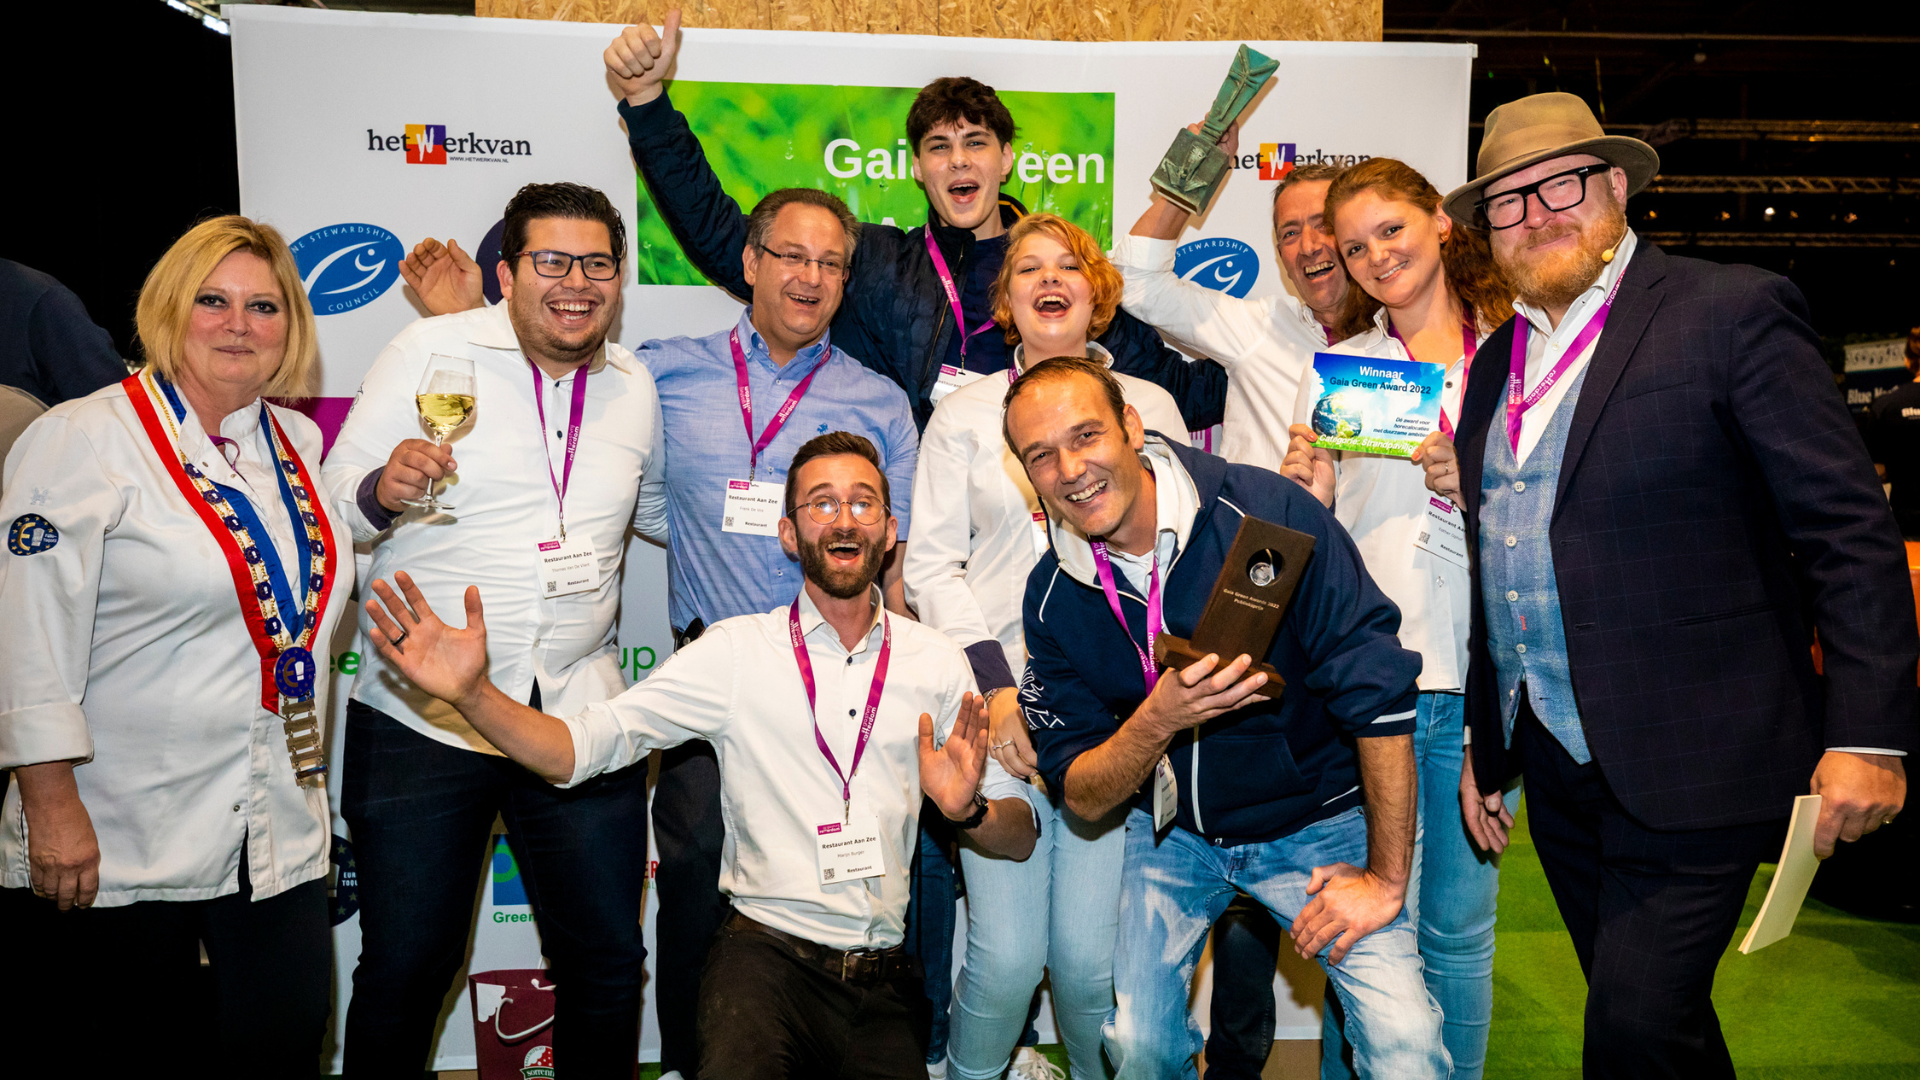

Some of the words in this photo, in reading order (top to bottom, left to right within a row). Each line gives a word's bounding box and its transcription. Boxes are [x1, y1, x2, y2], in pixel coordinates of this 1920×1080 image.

[824, 138, 914, 180] Gai
[1012, 150, 1105, 184] een
[309, 226, 392, 242] STEWARDSHIP
[1176, 240, 1249, 258] STEWARDSHIP
[328, 288, 380, 312] COUNCIL
[1359, 366, 1405, 380] Winnaar
[1329, 376, 1350, 387] Gaia
[1351, 378, 1378, 389] Green
[1379, 381, 1408, 392] Award
[1409, 384, 1432, 395] 2022
[1525, 369, 1557, 403] rotterdam
[568, 426, 580, 461] rotterdam
[1319, 434, 1360, 446] Categorie:
[728, 494, 756, 502] Restaurant
[1428, 511, 1457, 528] Restaurant
[543, 554, 572, 563] Restaurant
[861, 706, 877, 742] rotterdam
[821, 840, 853, 849] Restaurant
[343, 871, 357, 879] EUR
[847, 865, 872, 873] Restaurant
